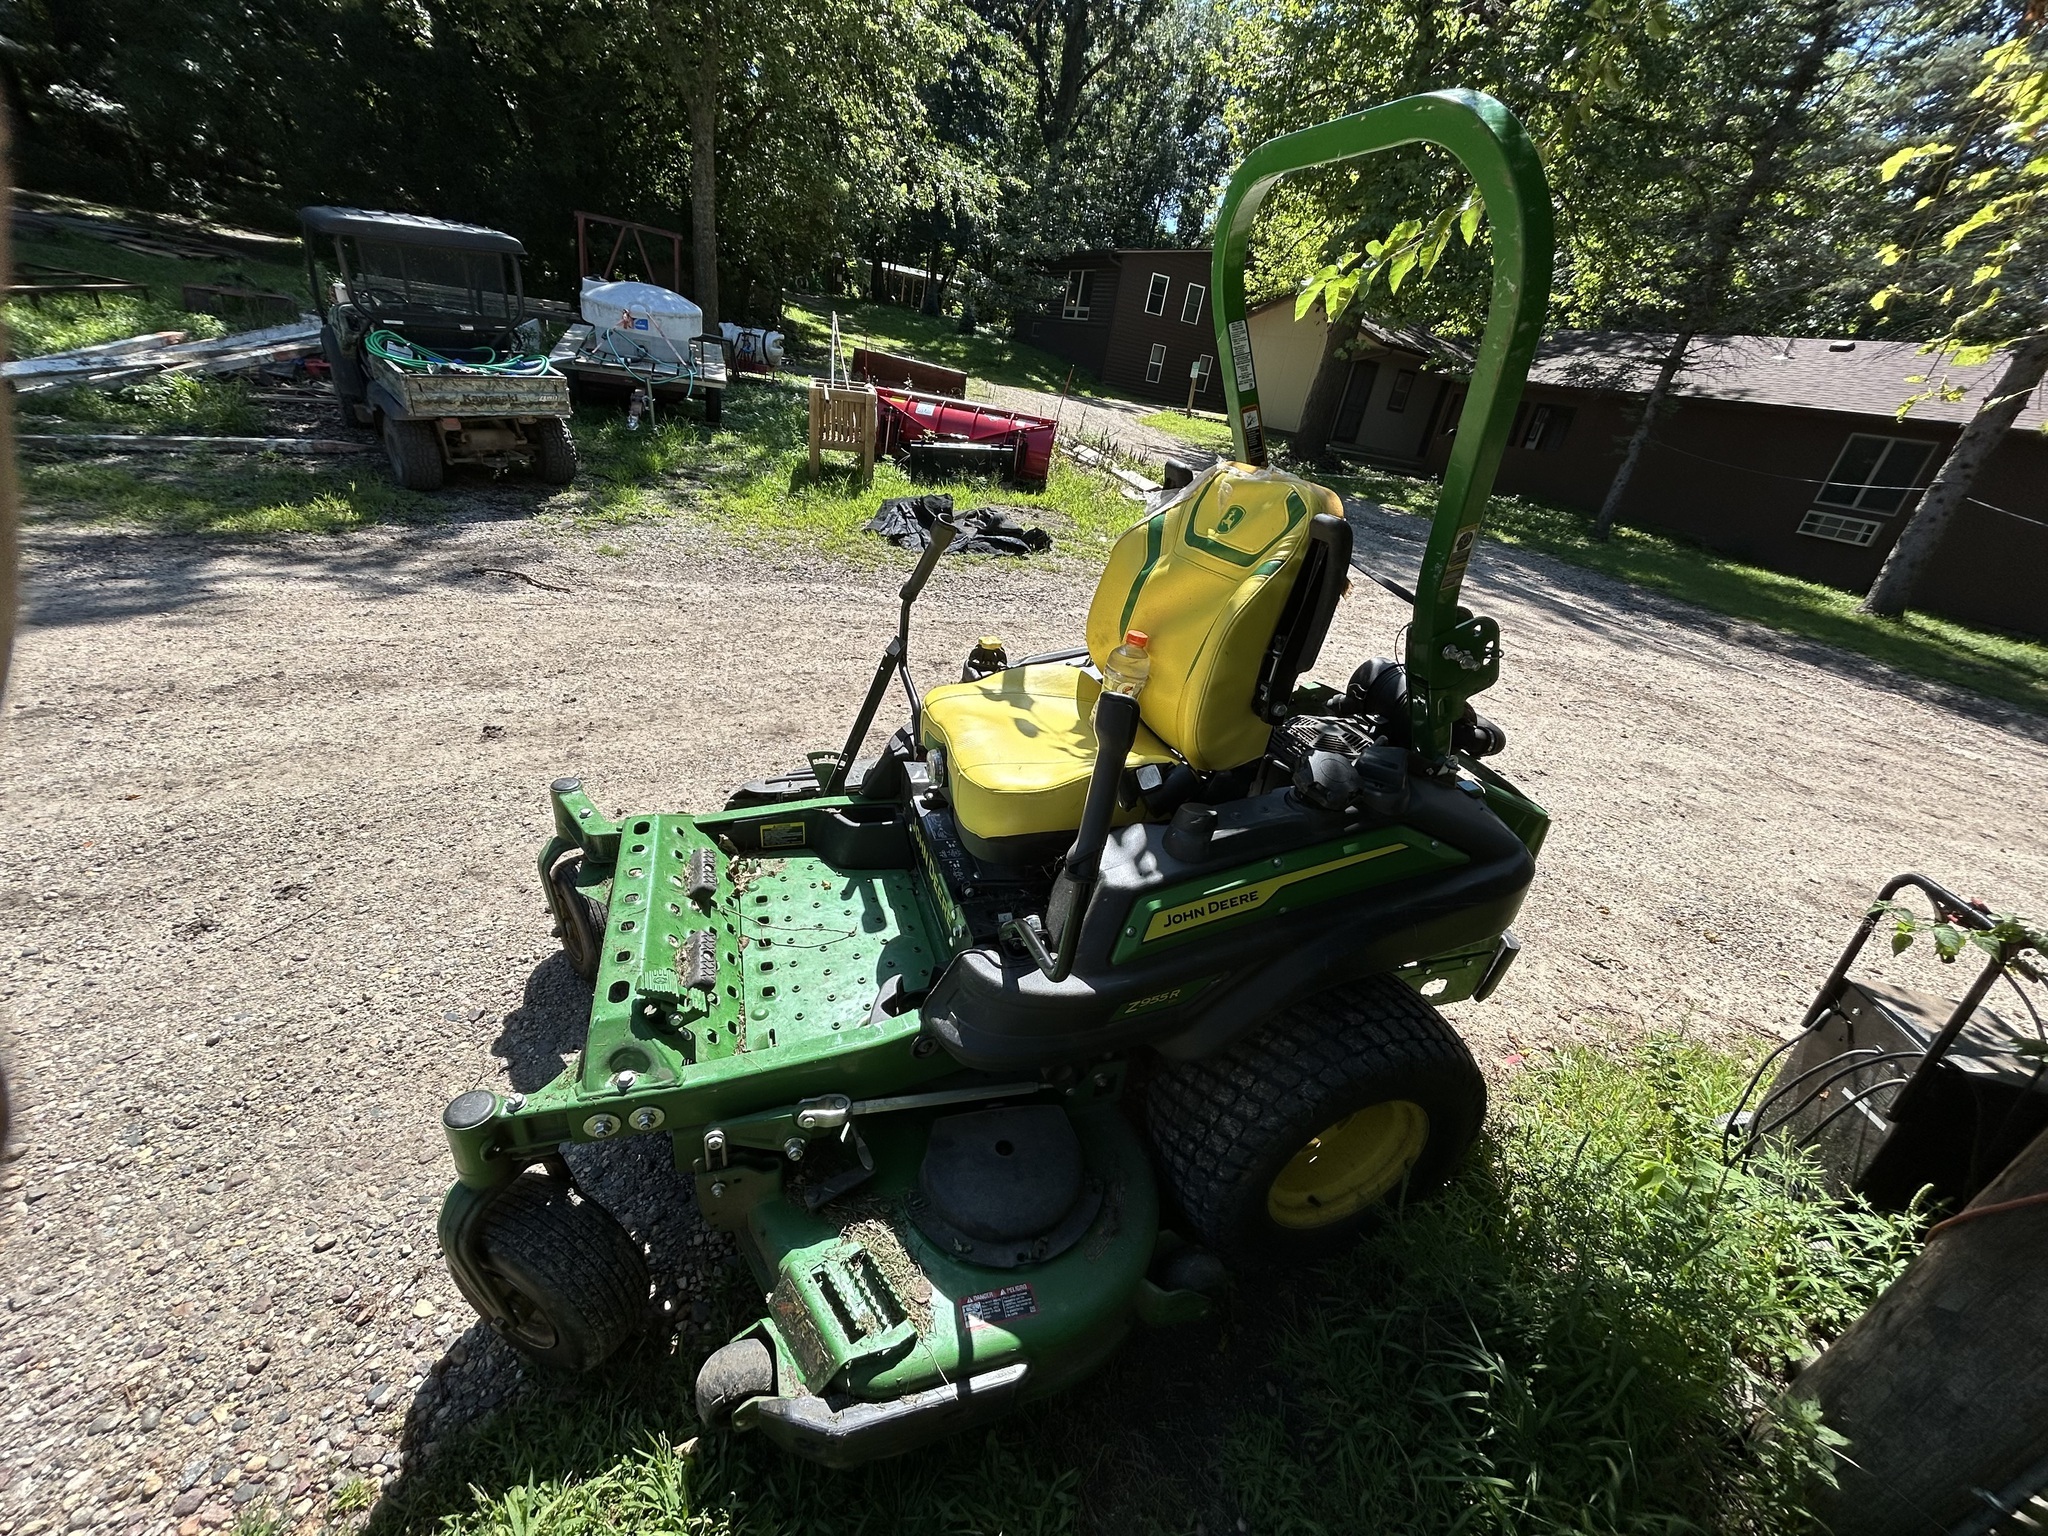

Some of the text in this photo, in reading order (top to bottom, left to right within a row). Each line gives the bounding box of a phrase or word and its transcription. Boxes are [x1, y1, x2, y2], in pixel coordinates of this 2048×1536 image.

[462, 393, 518, 403] Kawasaki
[1163, 890, 1259, 928] JOHN DEERE
[1124, 989, 1181, 1014] Z955R
[973, 1292, 993, 1301] DANGER
